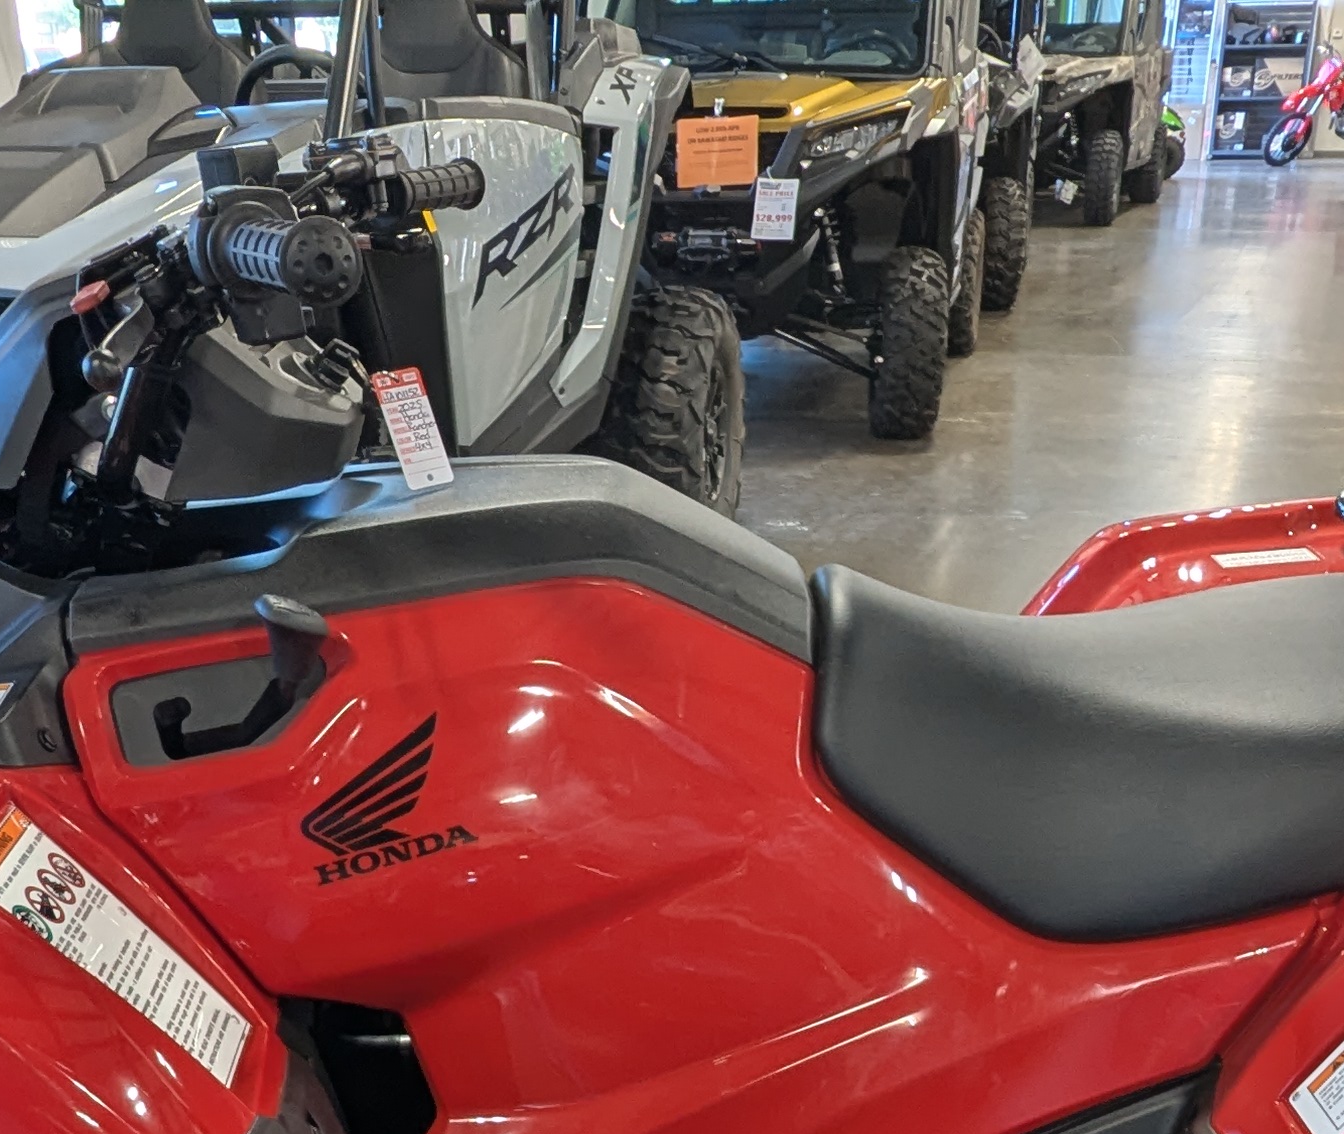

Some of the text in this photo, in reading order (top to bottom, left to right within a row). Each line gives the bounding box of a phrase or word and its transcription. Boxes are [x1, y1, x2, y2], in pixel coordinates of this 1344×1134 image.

[609, 66, 638, 105] XP
[472, 163, 576, 311] RZR
[313, 825, 479, 886] HONDA
